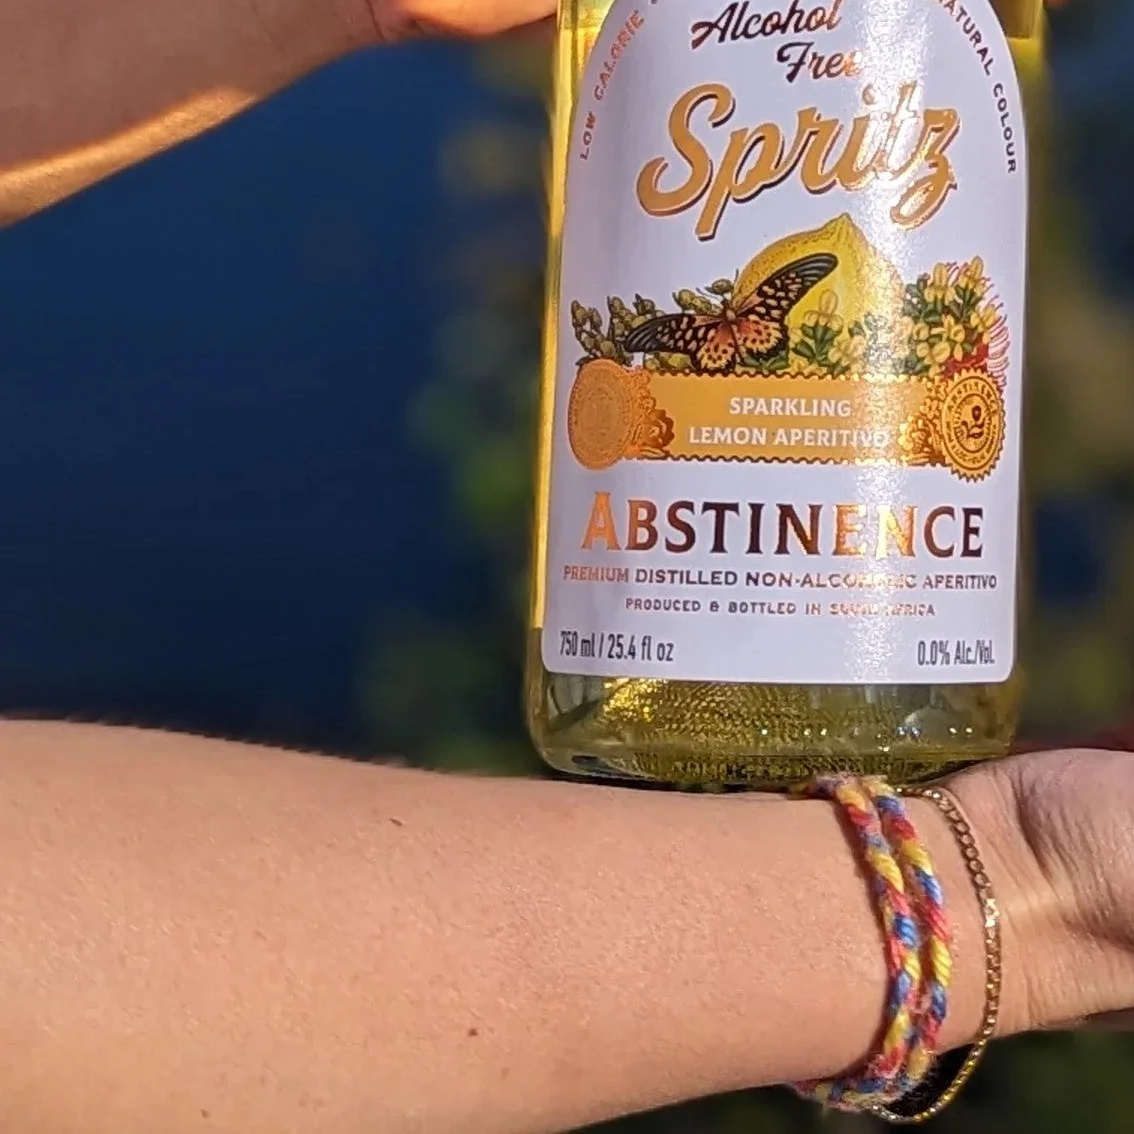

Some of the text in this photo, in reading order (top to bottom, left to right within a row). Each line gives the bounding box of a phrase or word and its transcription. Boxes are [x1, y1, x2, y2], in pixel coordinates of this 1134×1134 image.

[579, 111, 596, 161] LOW
[993, 83, 1018, 174] COLOUR
[635, 82, 961, 242] Spritz
[728, 397, 852, 417] SPARKLING
[689, 426, 890, 449] LEMON APERITIVO
[580, 491, 984, 559] ABSTINENCE
[563, 564, 630, 584] PREMIUM
[635, 568, 738, 586] DISTILLED
[922, 574, 998, 590] APERITIVO
[625, 597, 702, 613] PRODUCED
[728, 601, 796, 614] BOTTLED
[805, 602, 821, 615] IN
[560, 630, 578, 657] 750
[607, 633, 637, 660] 25.4
[641, 635, 653, 661] fl
[656, 642, 674, 662] oz
[917, 640, 951, 666] 0.0%
